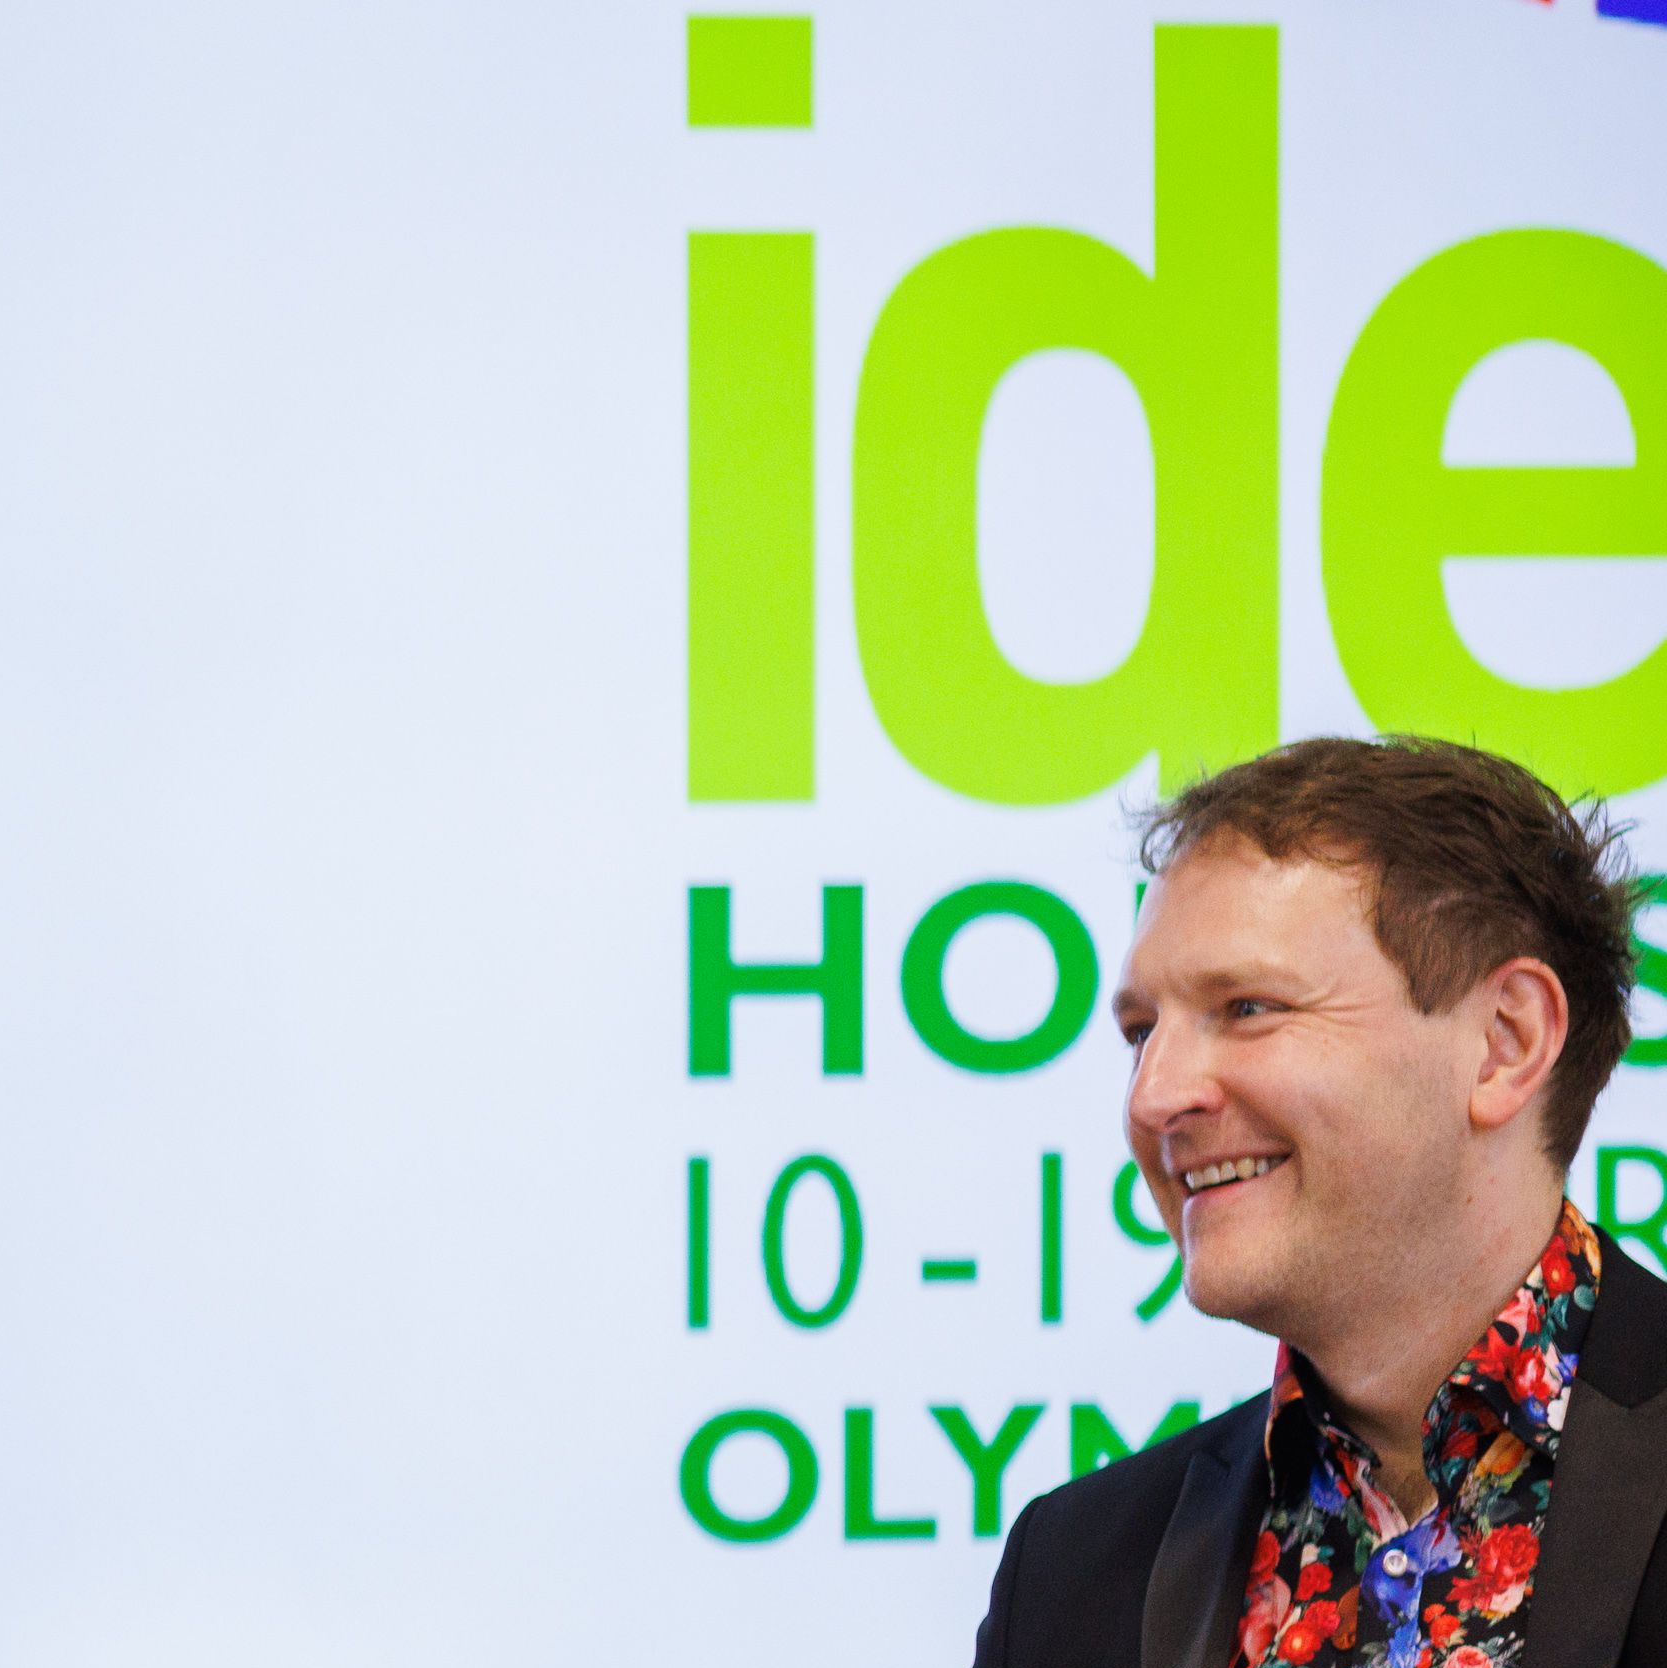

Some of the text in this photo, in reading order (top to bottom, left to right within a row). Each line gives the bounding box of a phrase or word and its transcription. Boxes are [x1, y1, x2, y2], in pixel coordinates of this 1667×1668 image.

[685, 12, 1667, 808] ide
[687, 878, 1147, 1076] HO
[688, 1153, 1184, 1330] 10-19
[679, 1402, 1270, 1545] OLYM
